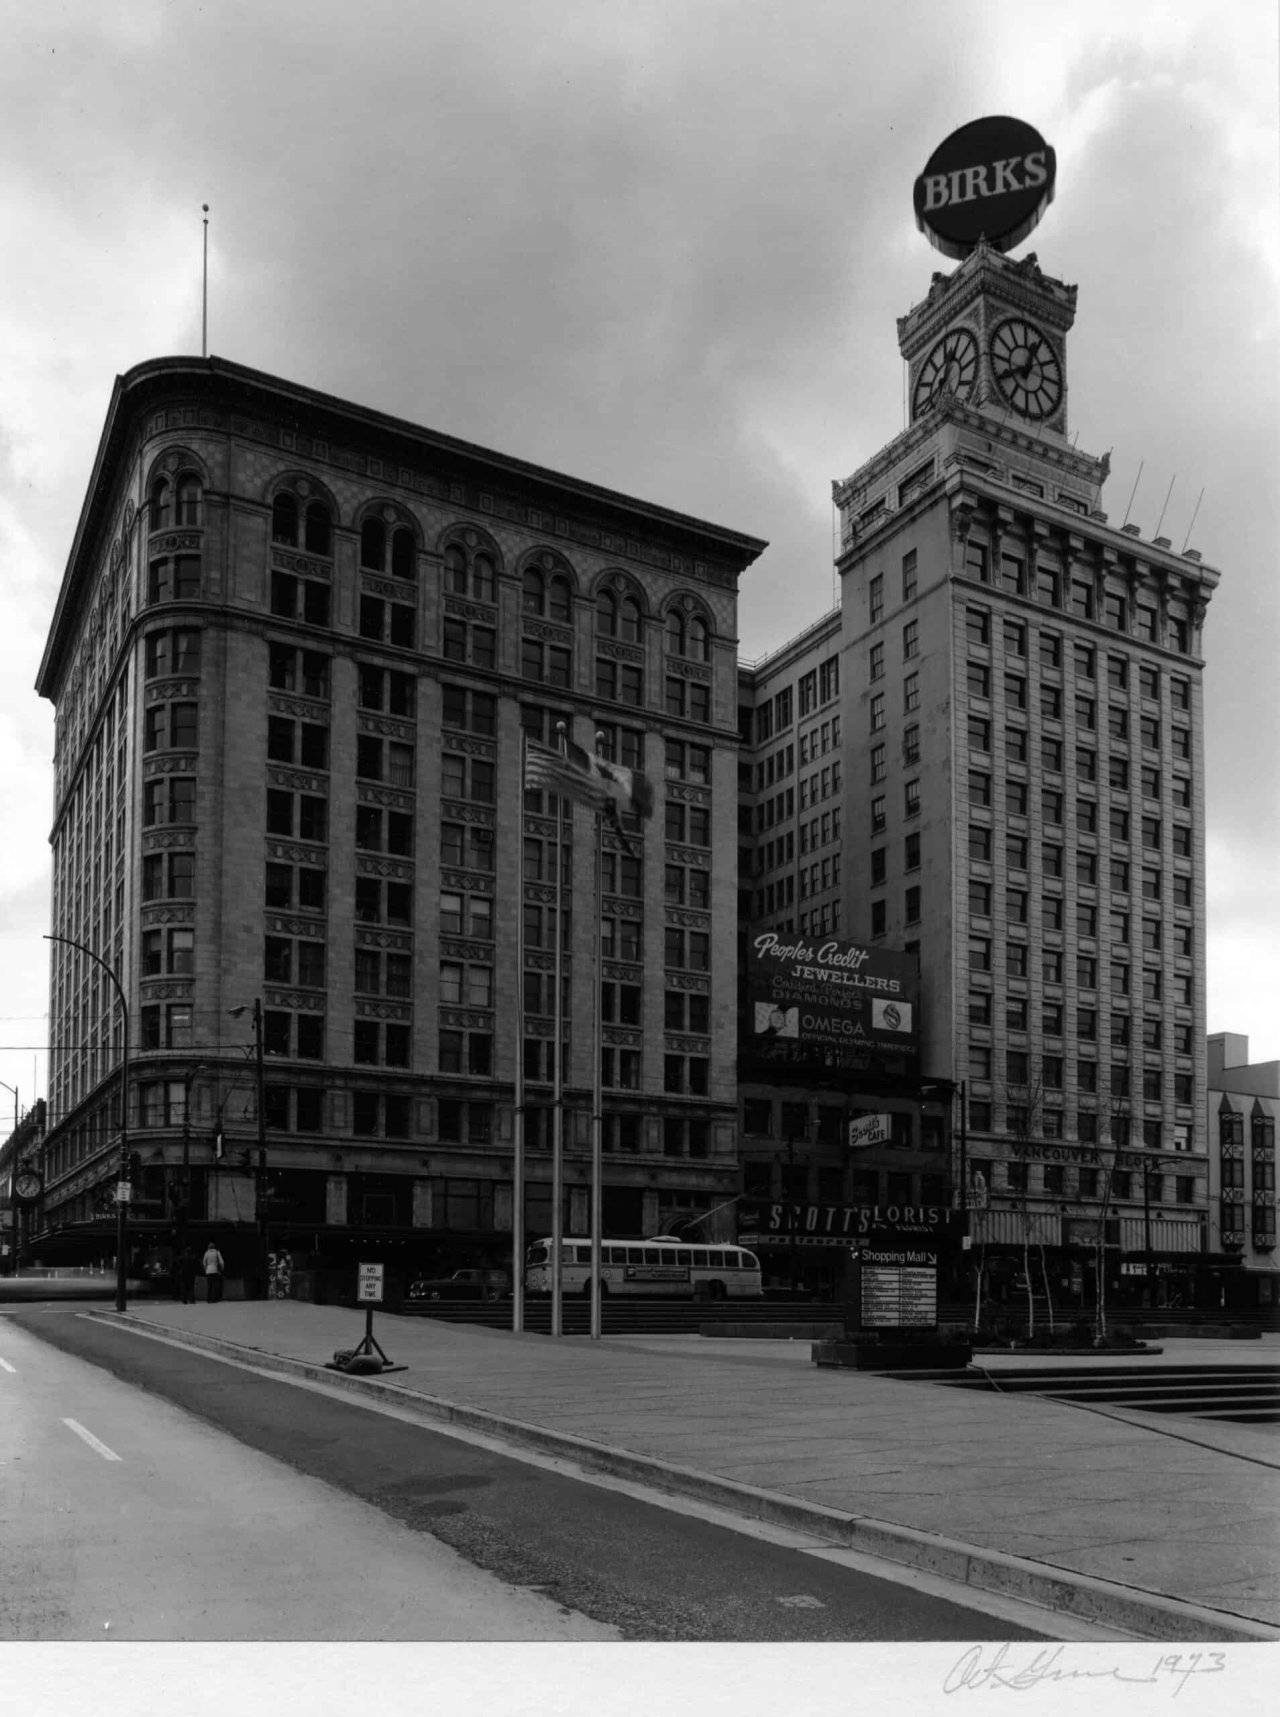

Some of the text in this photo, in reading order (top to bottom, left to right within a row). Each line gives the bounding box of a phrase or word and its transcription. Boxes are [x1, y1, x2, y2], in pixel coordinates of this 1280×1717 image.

[923, 150, 1047, 210] BIRKS
[754, 933, 869, 968] Peoples Credit
[791, 965, 900, 992] JEWELLERS
[772, 989, 862, 1010] DIAMONDS
[802, 1015, 865, 1036] OMEGA
[868, 1130, 885, 1142] CAFE
[1011, 1144, 1159, 1171] VANCOUVER BLOCK
[862, 1249, 926, 1264] Shopping Mall
[367, 1266, 376, 1274] NO
[1153, 1652, 1227, 1699] 1973
